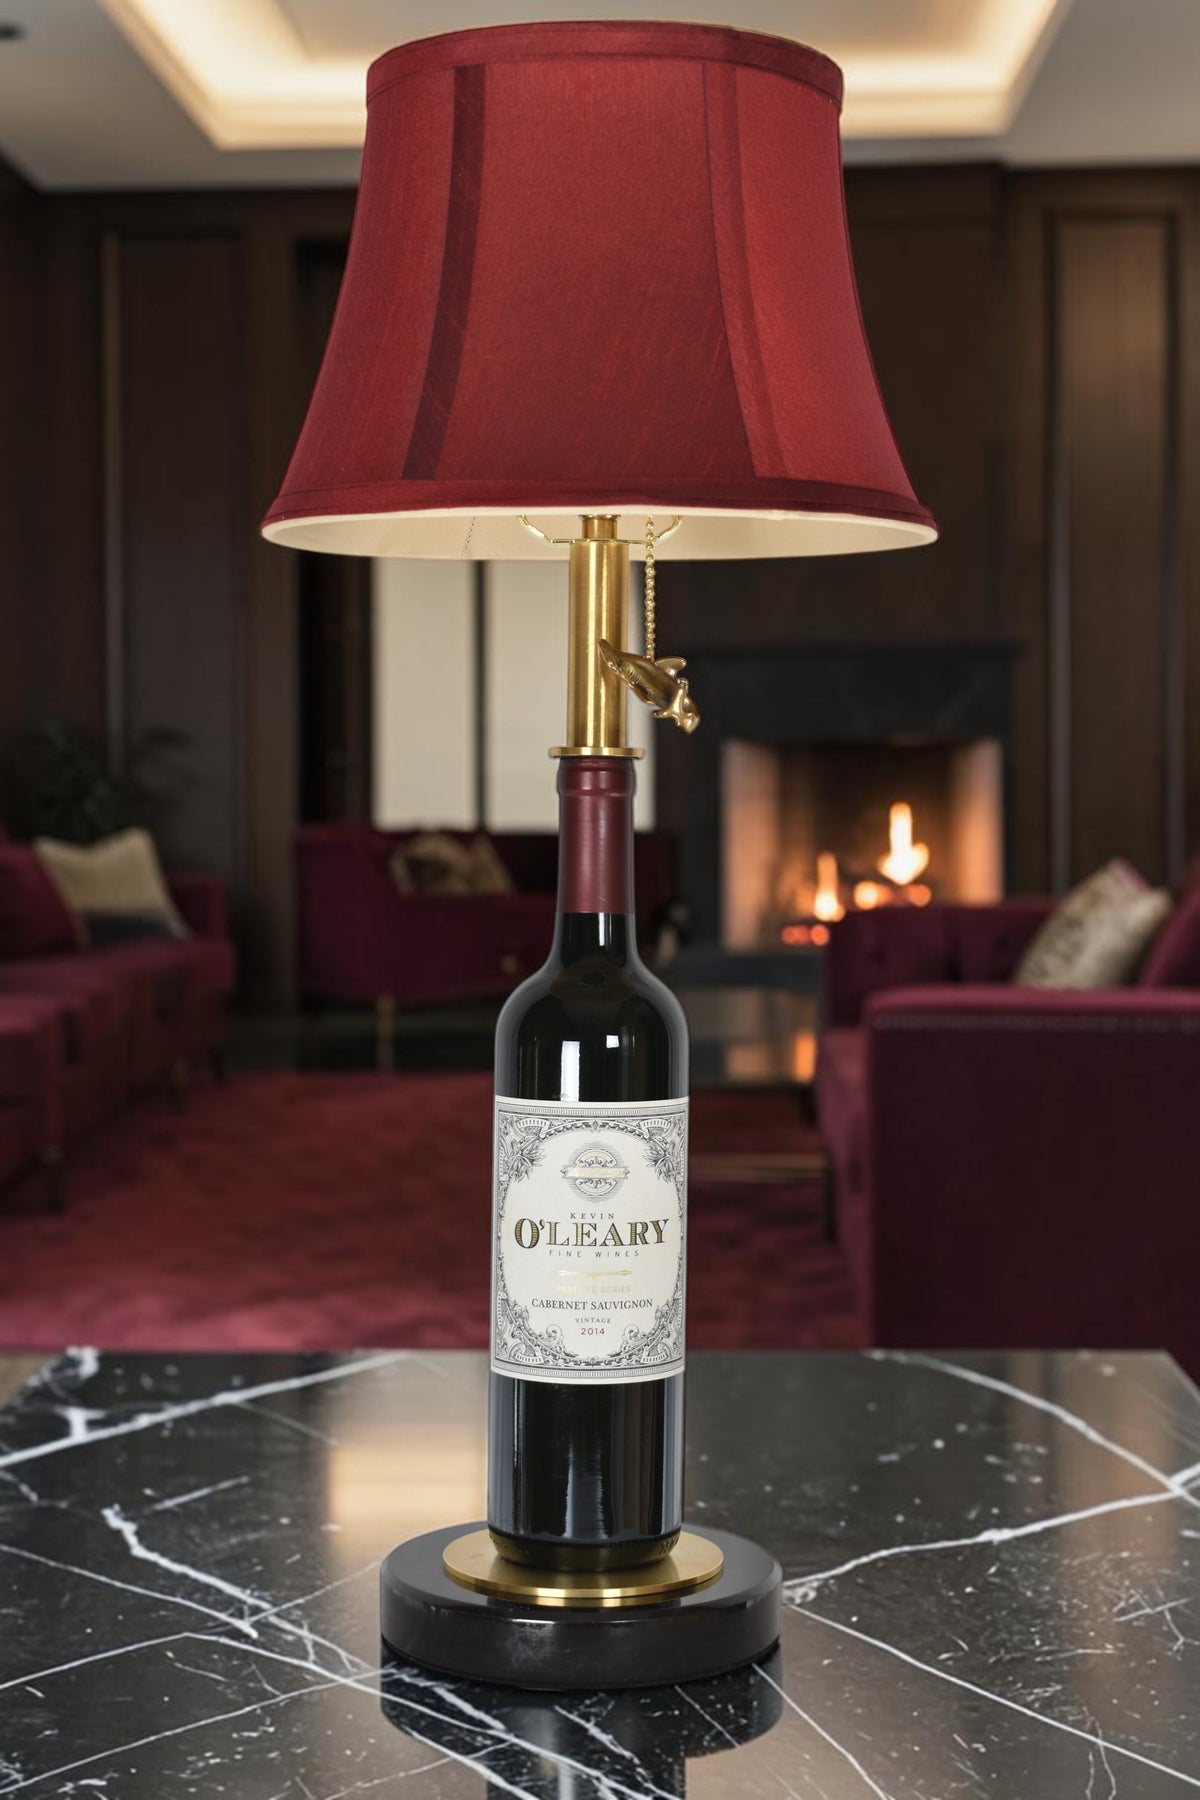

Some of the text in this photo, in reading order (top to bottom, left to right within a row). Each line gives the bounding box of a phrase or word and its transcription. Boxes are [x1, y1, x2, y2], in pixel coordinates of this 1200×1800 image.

[514, 1218, 670, 1249] O'LEARY
[549, 1250, 640, 1258] FINE WINES
[601, 1285, 632, 1294] SERIES
[531, 1298, 654, 1310] CABERNET SAUVIGNON
[580, 1327, 606, 1336] 2014
